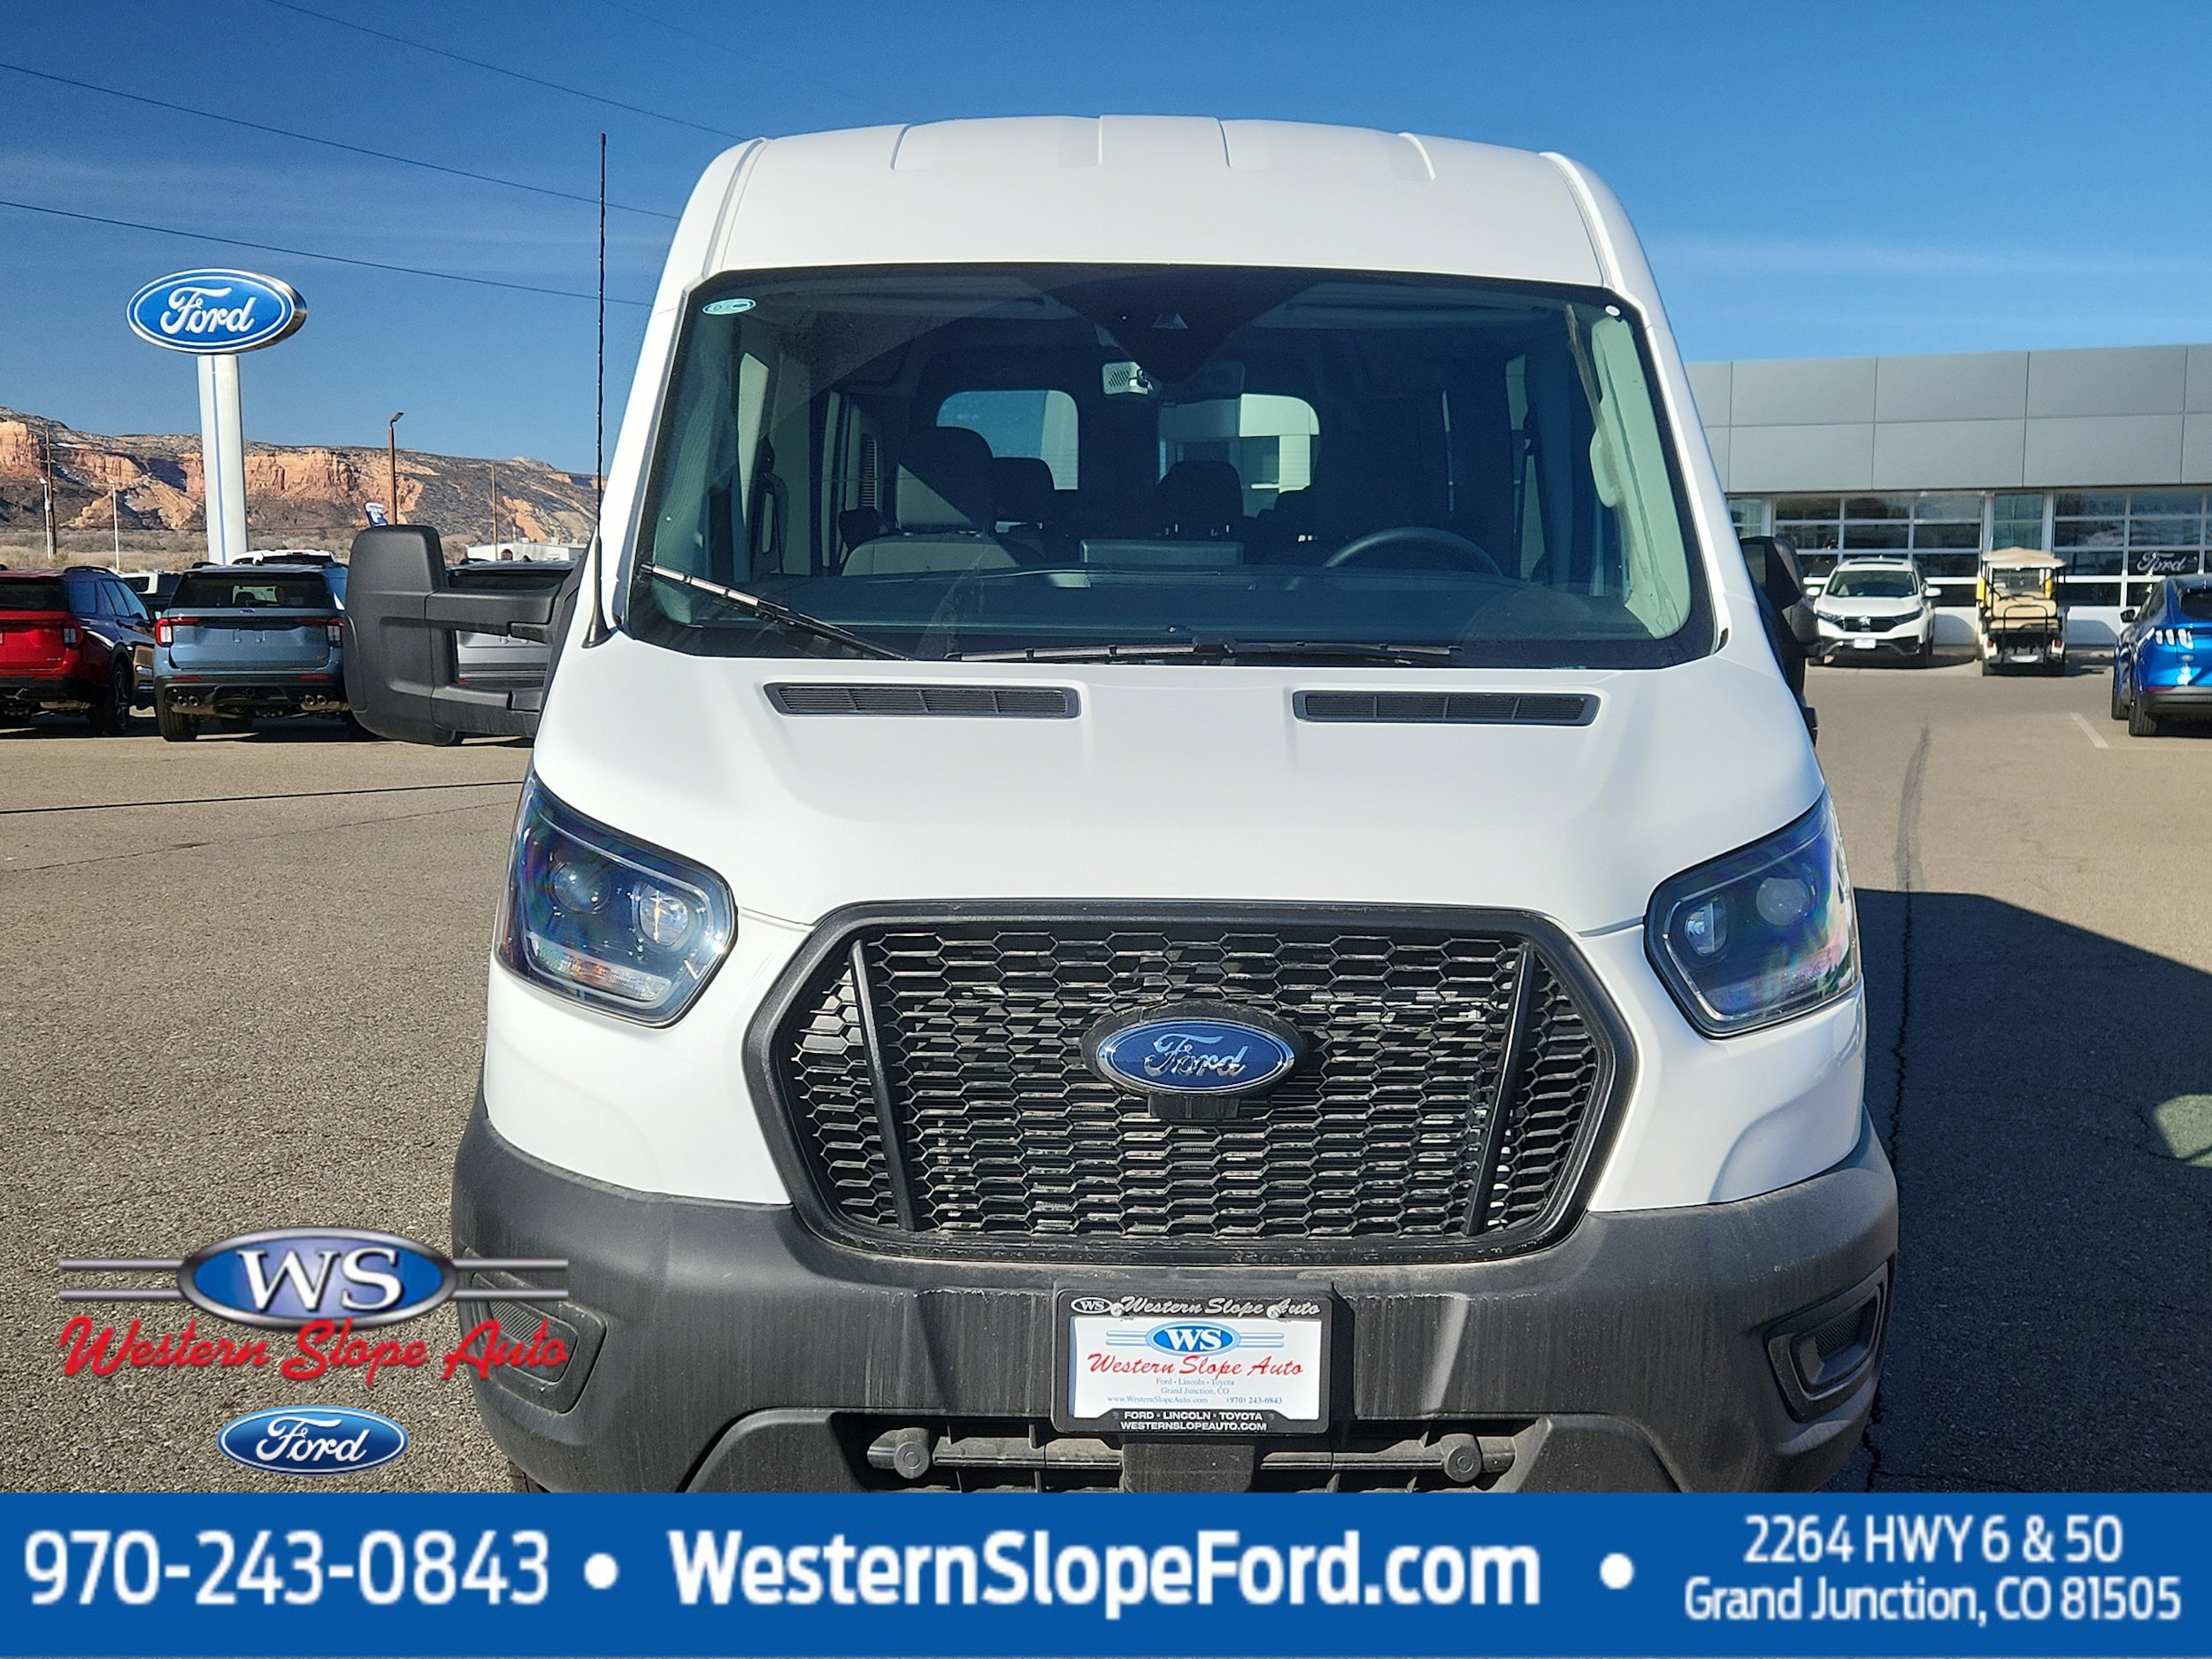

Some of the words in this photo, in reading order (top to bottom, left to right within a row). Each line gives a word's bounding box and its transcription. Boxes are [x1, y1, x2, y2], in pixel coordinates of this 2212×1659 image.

[160, 286, 257, 334] Ford
[2136, 552, 2187, 572] Ford
[1144, 1033, 1248, 1077] Ford
[1079, 1301, 1105, 1311] WS
[1120, 1295, 1203, 1314] Western
[1204, 1297, 1264, 1318] Slope
[1164, 1328, 1223, 1351] WS
[1087, 1353, 1176, 1374] Western
[1179, 1354, 1243, 1380] Slope
[1246, 1355, 1304, 1377] Auto
[1156, 1377, 1172, 1386] Ford
[1211, 1379, 1235, 1388] Toyota
[1120, 1421, 1267, 1431] WESTERNSLOPEAUTO.COM
[1124, 1411, 1155, 1420] FORD
[1163, 1411, 1211, 1420] LINCOLN
[1218, 1412, 1263, 1421] TOYOTA
